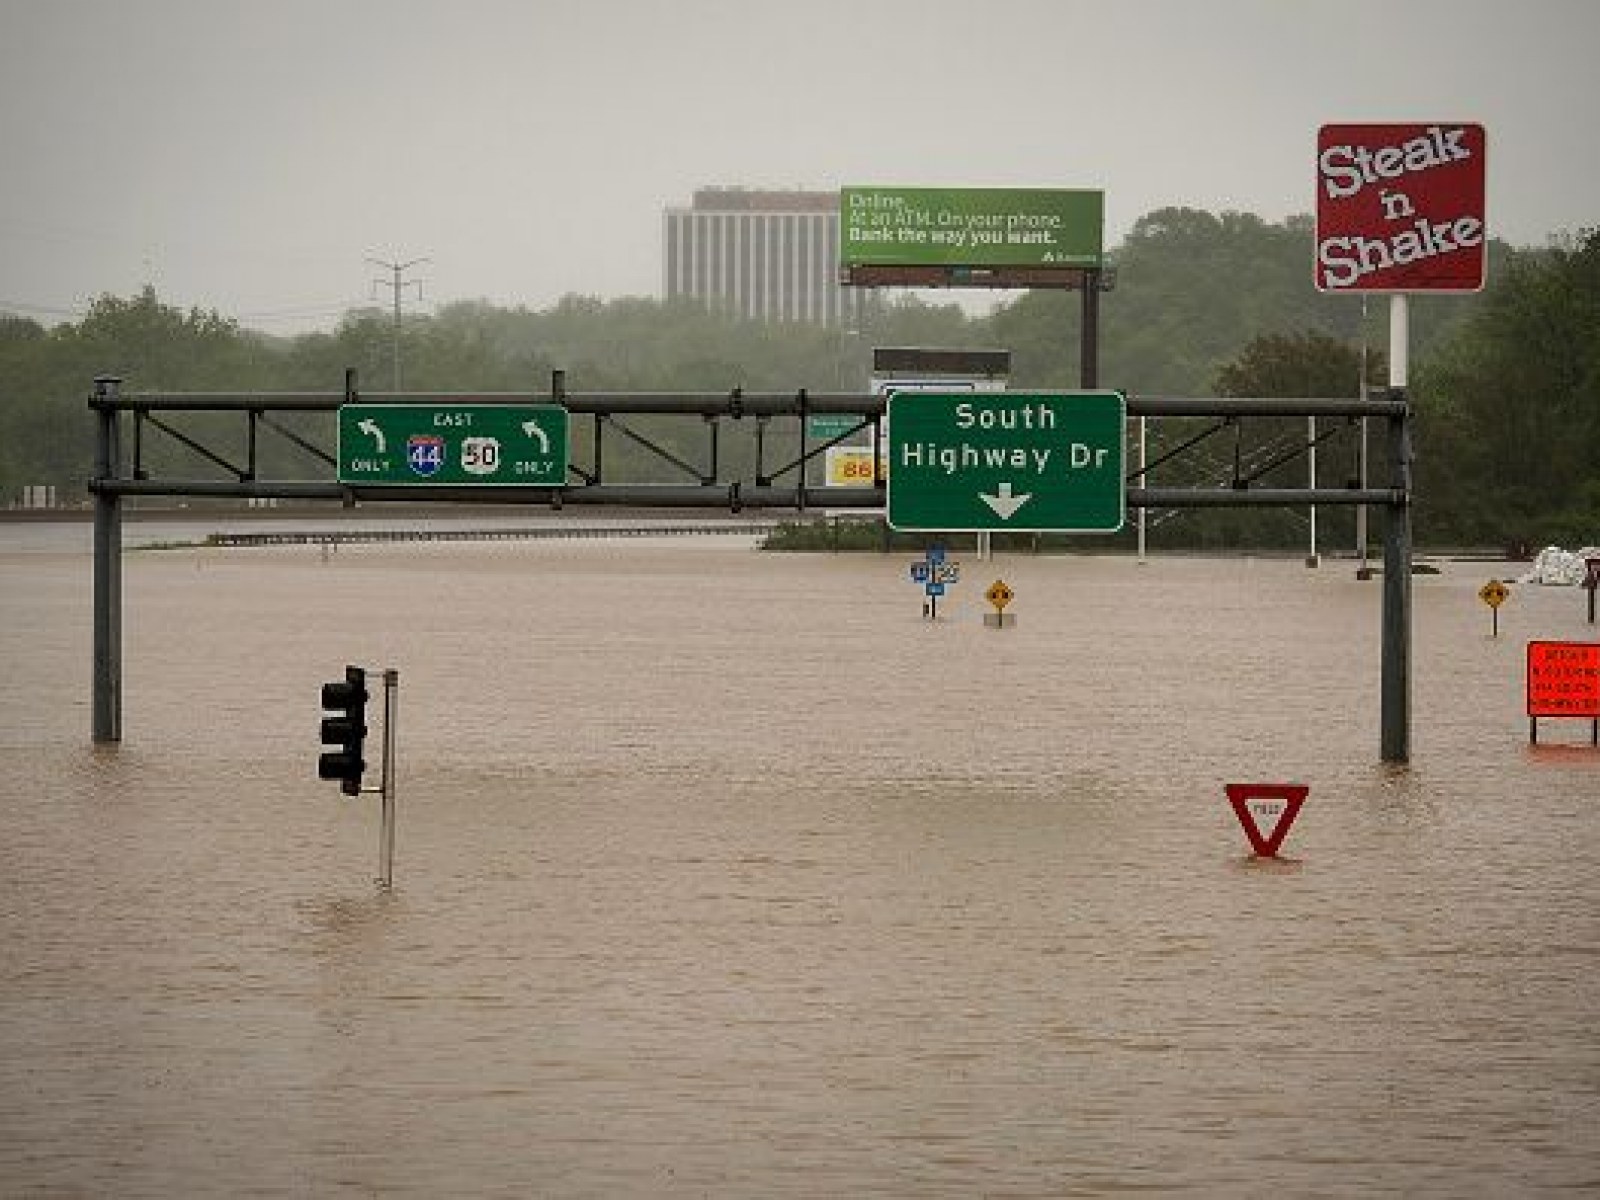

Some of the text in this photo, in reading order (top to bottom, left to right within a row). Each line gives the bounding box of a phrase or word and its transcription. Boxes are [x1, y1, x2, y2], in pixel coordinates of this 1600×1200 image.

[1320, 127, 1471, 198] Steak
[870, 211, 891, 226] an
[937, 210, 963, 226] On
[963, 214, 1003, 232] your
[849, 227, 1058, 247] Bank the way you want.
[1320, 218, 1483, 286] Shake
[433, 412, 474, 427] EAST
[955, 403, 1056, 429] South
[352, 459, 390, 472] ONLY
[412, 446, 440, 466] 44
[463, 445, 496, 466] 50
[903, 442, 1109, 475] Highway Dr
